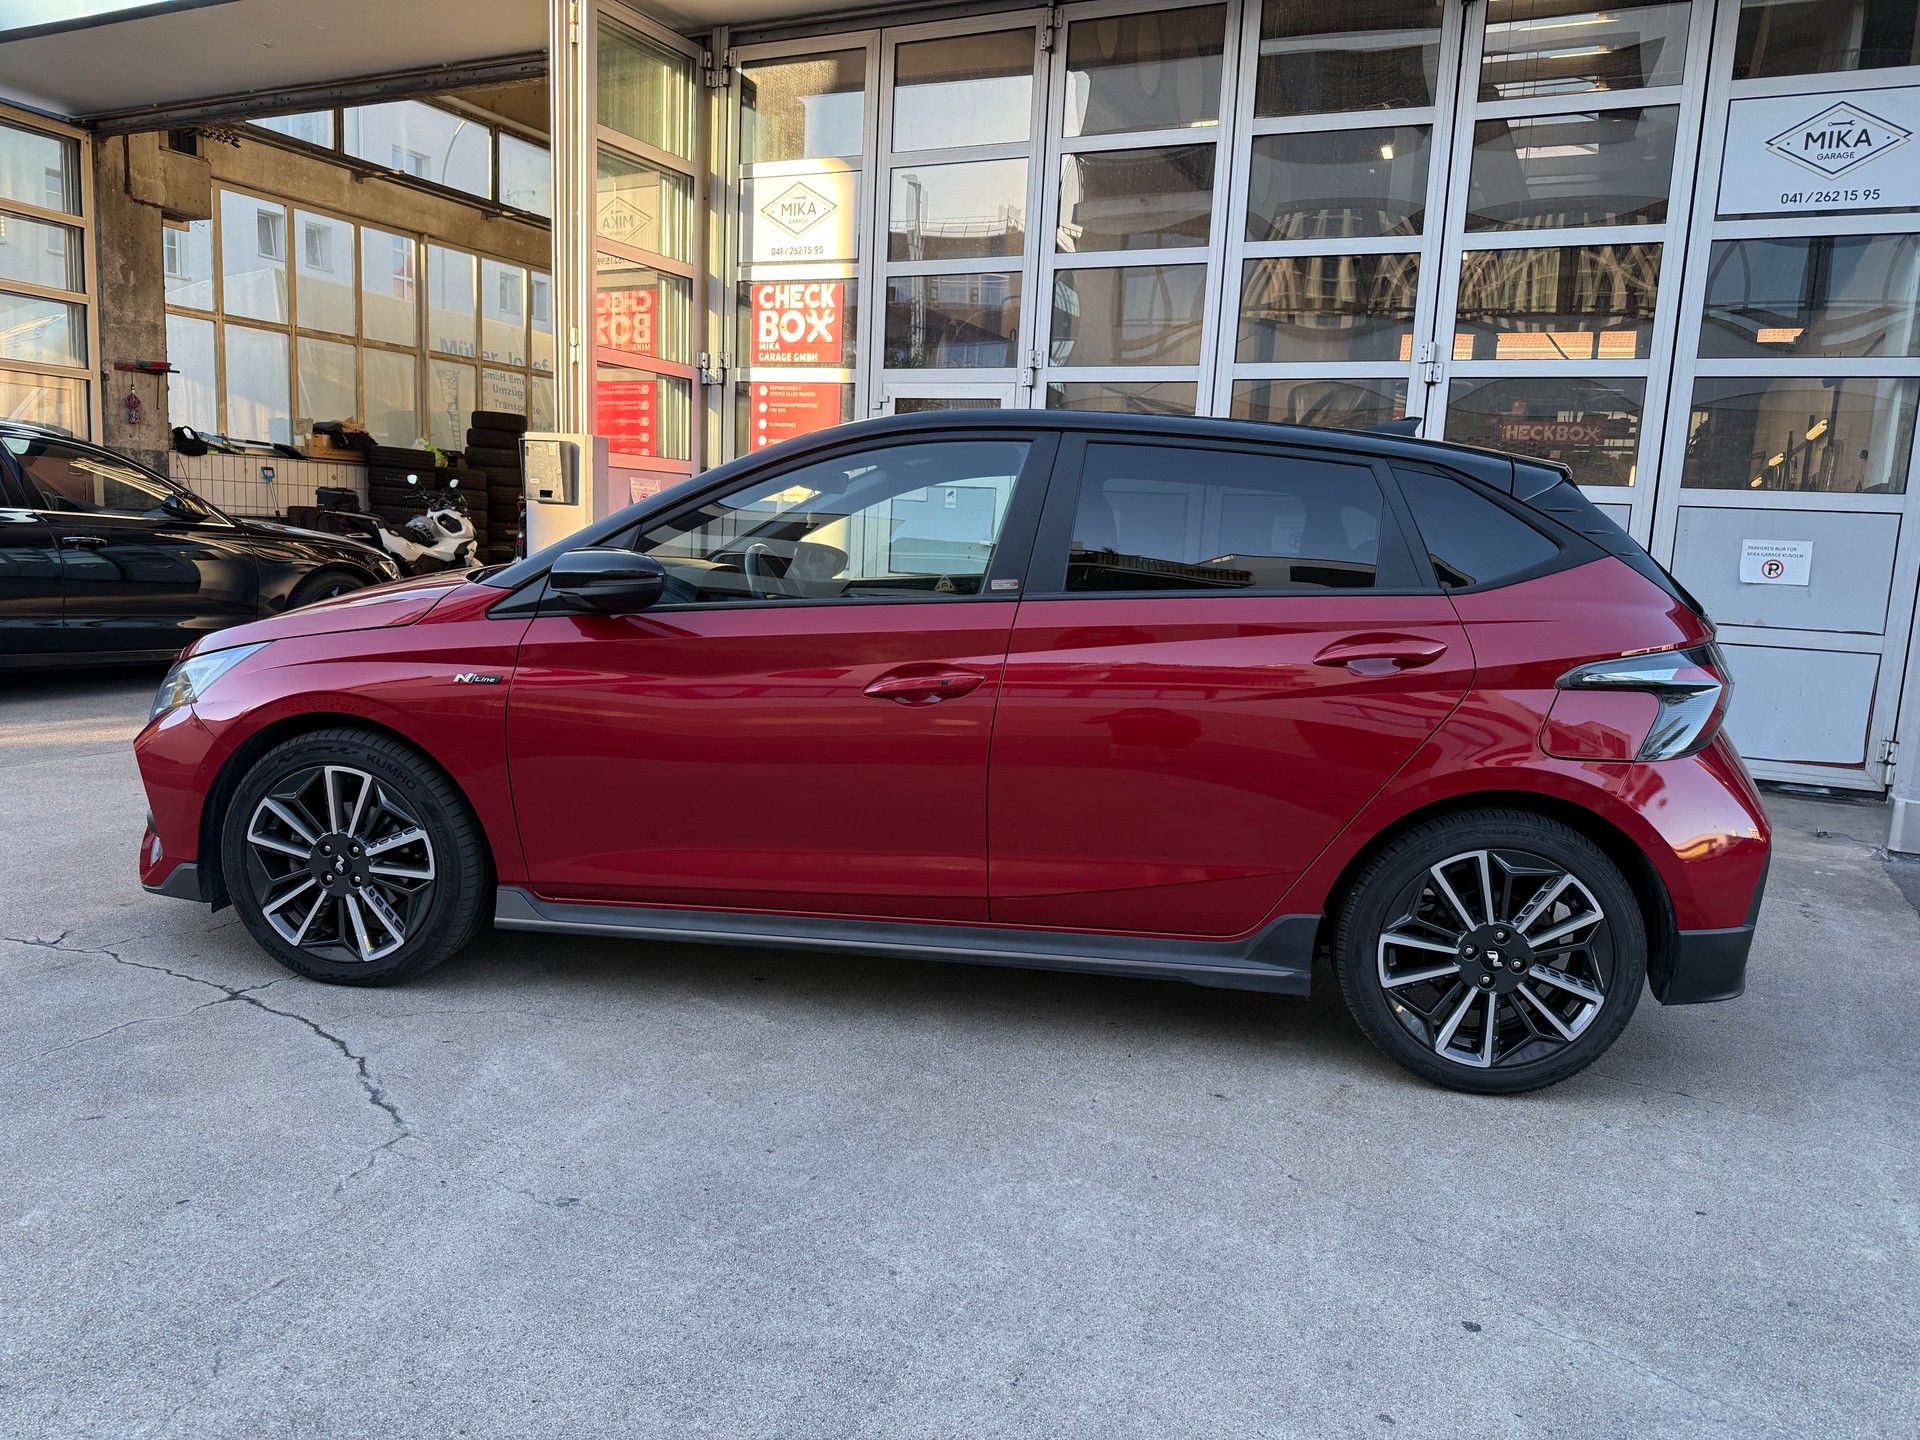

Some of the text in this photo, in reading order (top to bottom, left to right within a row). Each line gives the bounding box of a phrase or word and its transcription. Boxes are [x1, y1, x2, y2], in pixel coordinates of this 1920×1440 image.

[1804, 128, 1872, 150] MIKA
[1816, 151, 1856, 160] GARAGE
[1843, 189, 1858, 201] 15
[1863, 188, 1881, 200] 95
[781, 202, 817, 217] MIKA
[804, 246, 813, 255] 15
[814, 245, 824, 255] 95
[758, 284, 837, 309] CHECK
[758, 309, 836, 343] BOX
[758, 342, 781, 351] MIKA
[758, 352, 818, 362] GARAGE GMBH
[366, 753, 416, 790] KUMHO
[263, 938, 311, 973] KUMHO
